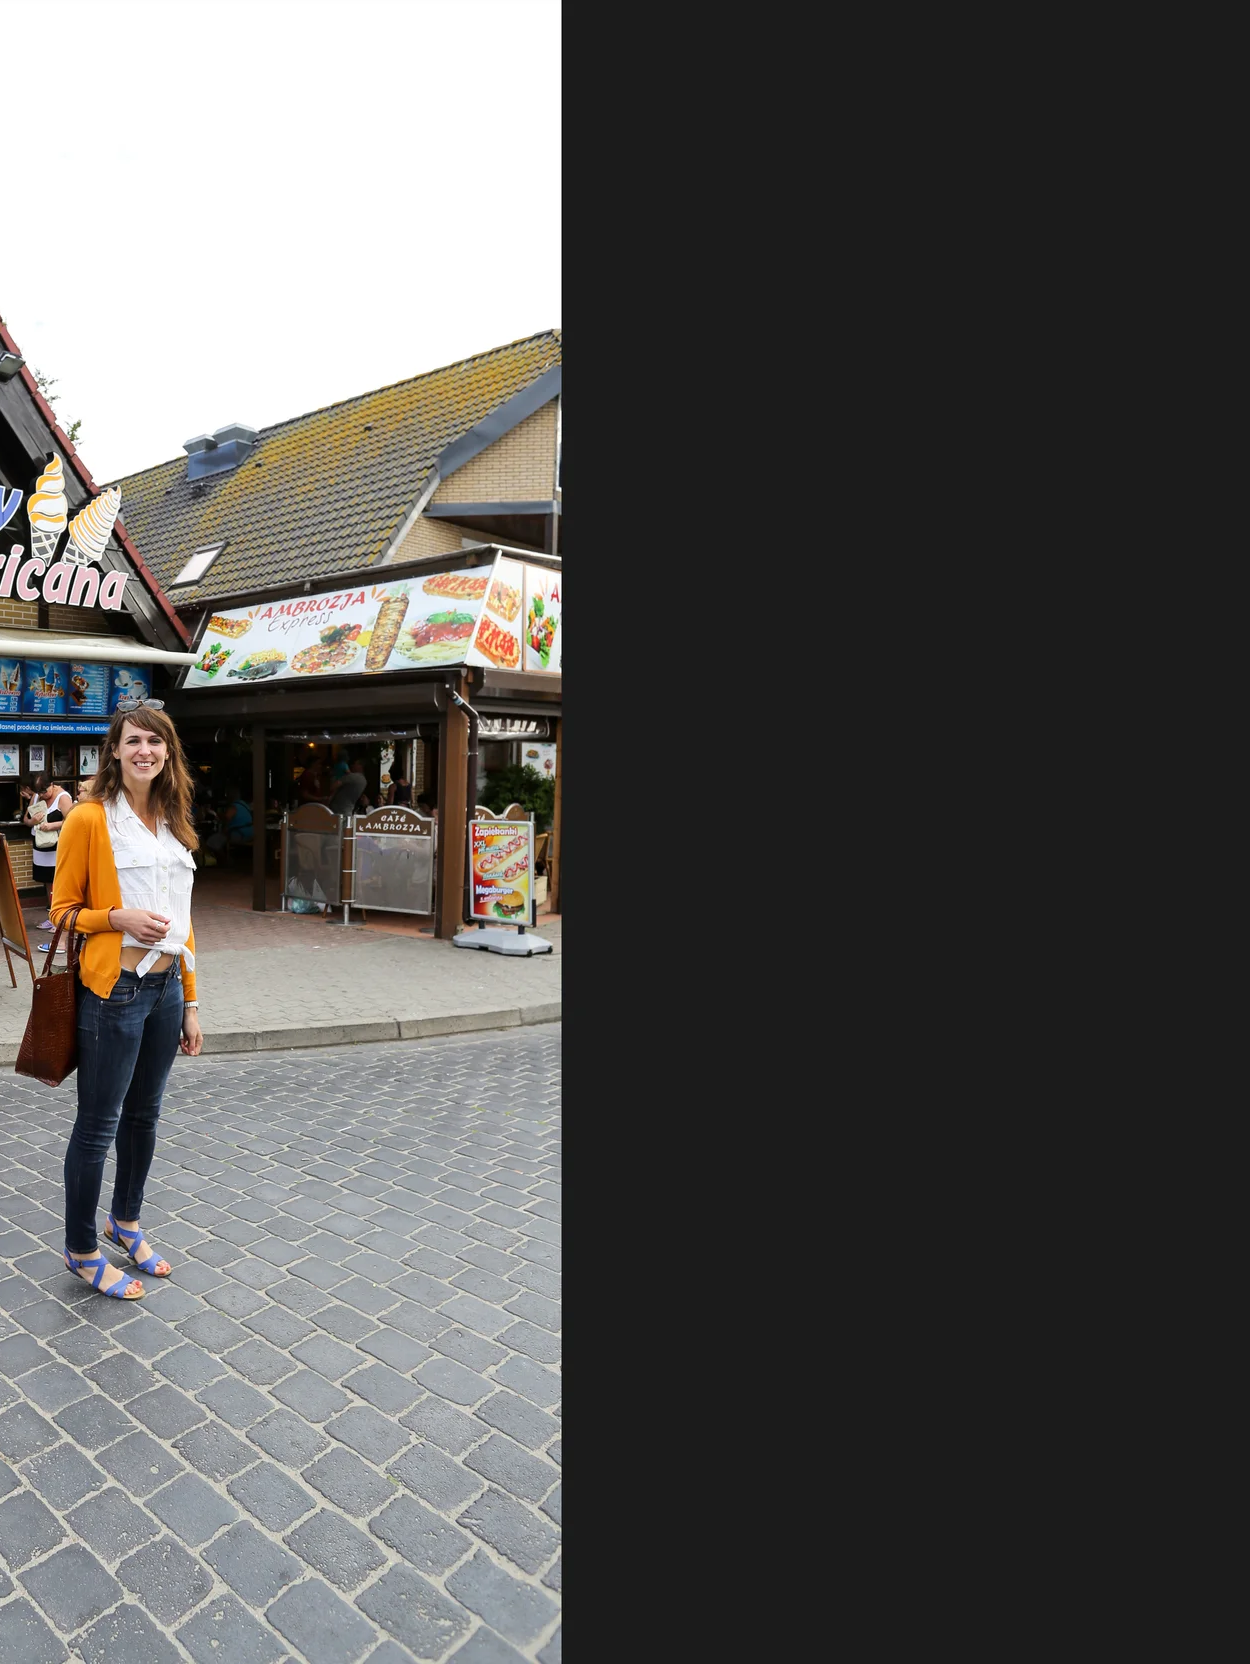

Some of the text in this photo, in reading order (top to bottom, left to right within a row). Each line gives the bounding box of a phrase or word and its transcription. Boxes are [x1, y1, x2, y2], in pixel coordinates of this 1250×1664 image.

[260, 591, 365, 621] AMBROZJA
[268, 611, 333, 636] Express
[17, 724, 41, 732] produkcji
[380, 814, 406, 823] CAFÉ
[365, 822, 421, 833] AMBROZJA
[474, 826, 518, 838] Zapiekanki
[475, 885, 514, 895] Megaburger
